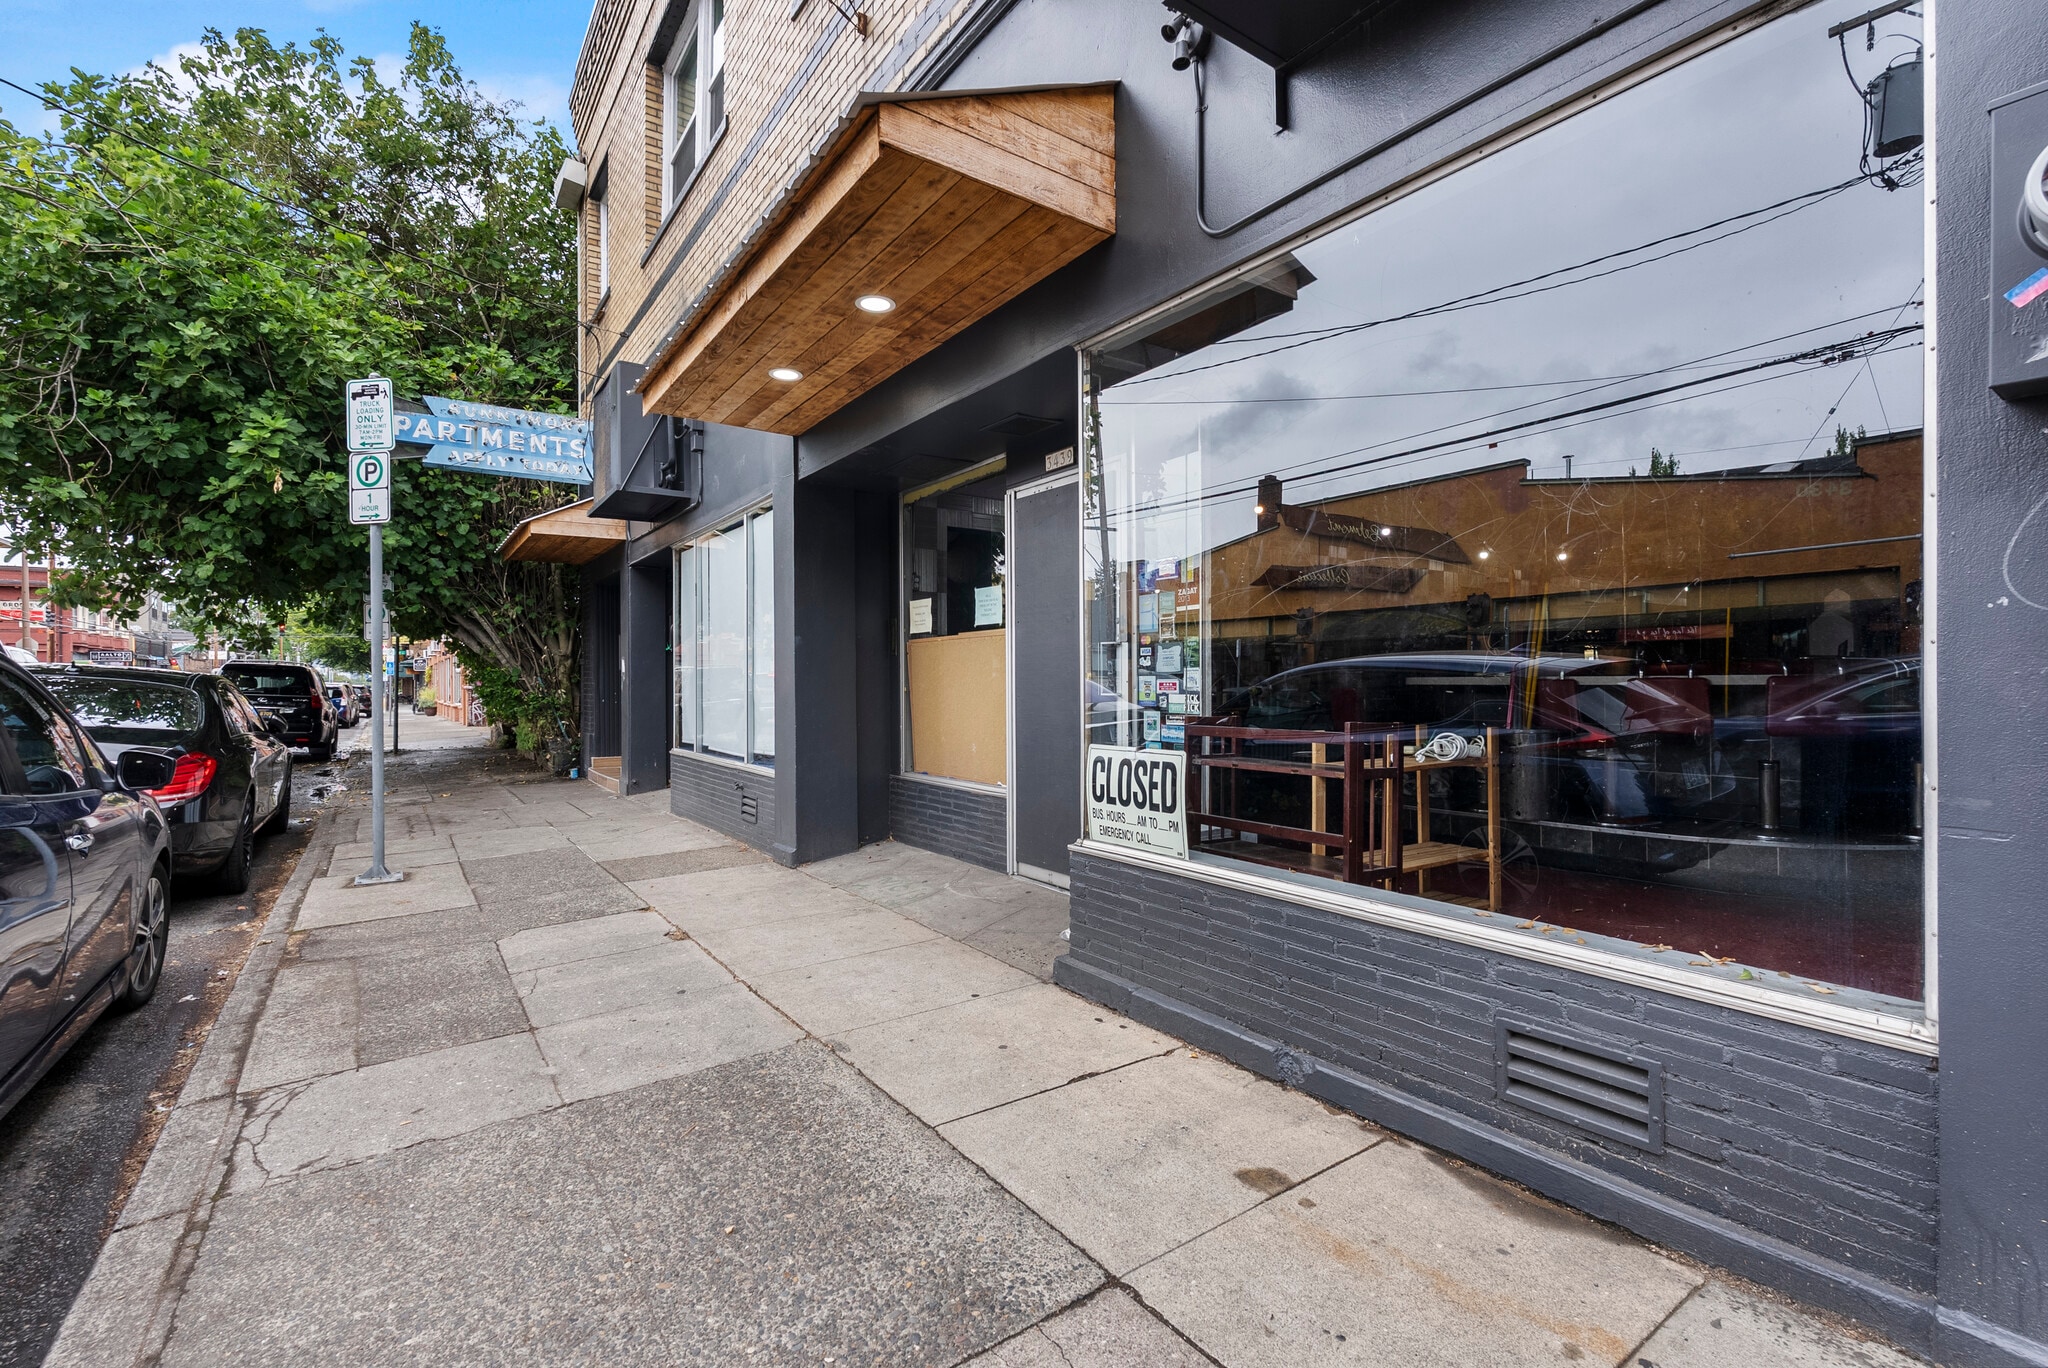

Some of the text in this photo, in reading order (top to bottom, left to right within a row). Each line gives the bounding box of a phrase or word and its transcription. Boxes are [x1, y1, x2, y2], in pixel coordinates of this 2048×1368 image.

[357, 414, 384, 423] ONLY
[394, 415, 586, 458] PARTMENTS
[450, 450, 583, 475] APPLY TODAY
[1046, 449, 1072, 470] 3439
[364, 462, 378, 481] P
[367, 492, 372, 504] 1
[1178, 587, 1198, 596] ZAGAT
[1092, 756, 1177, 814] CLOSED
[1092, 808, 1179, 833] BUS. HOURS AM TO PM
[1099, 825, 1152, 845] EMERGENCY CALL
